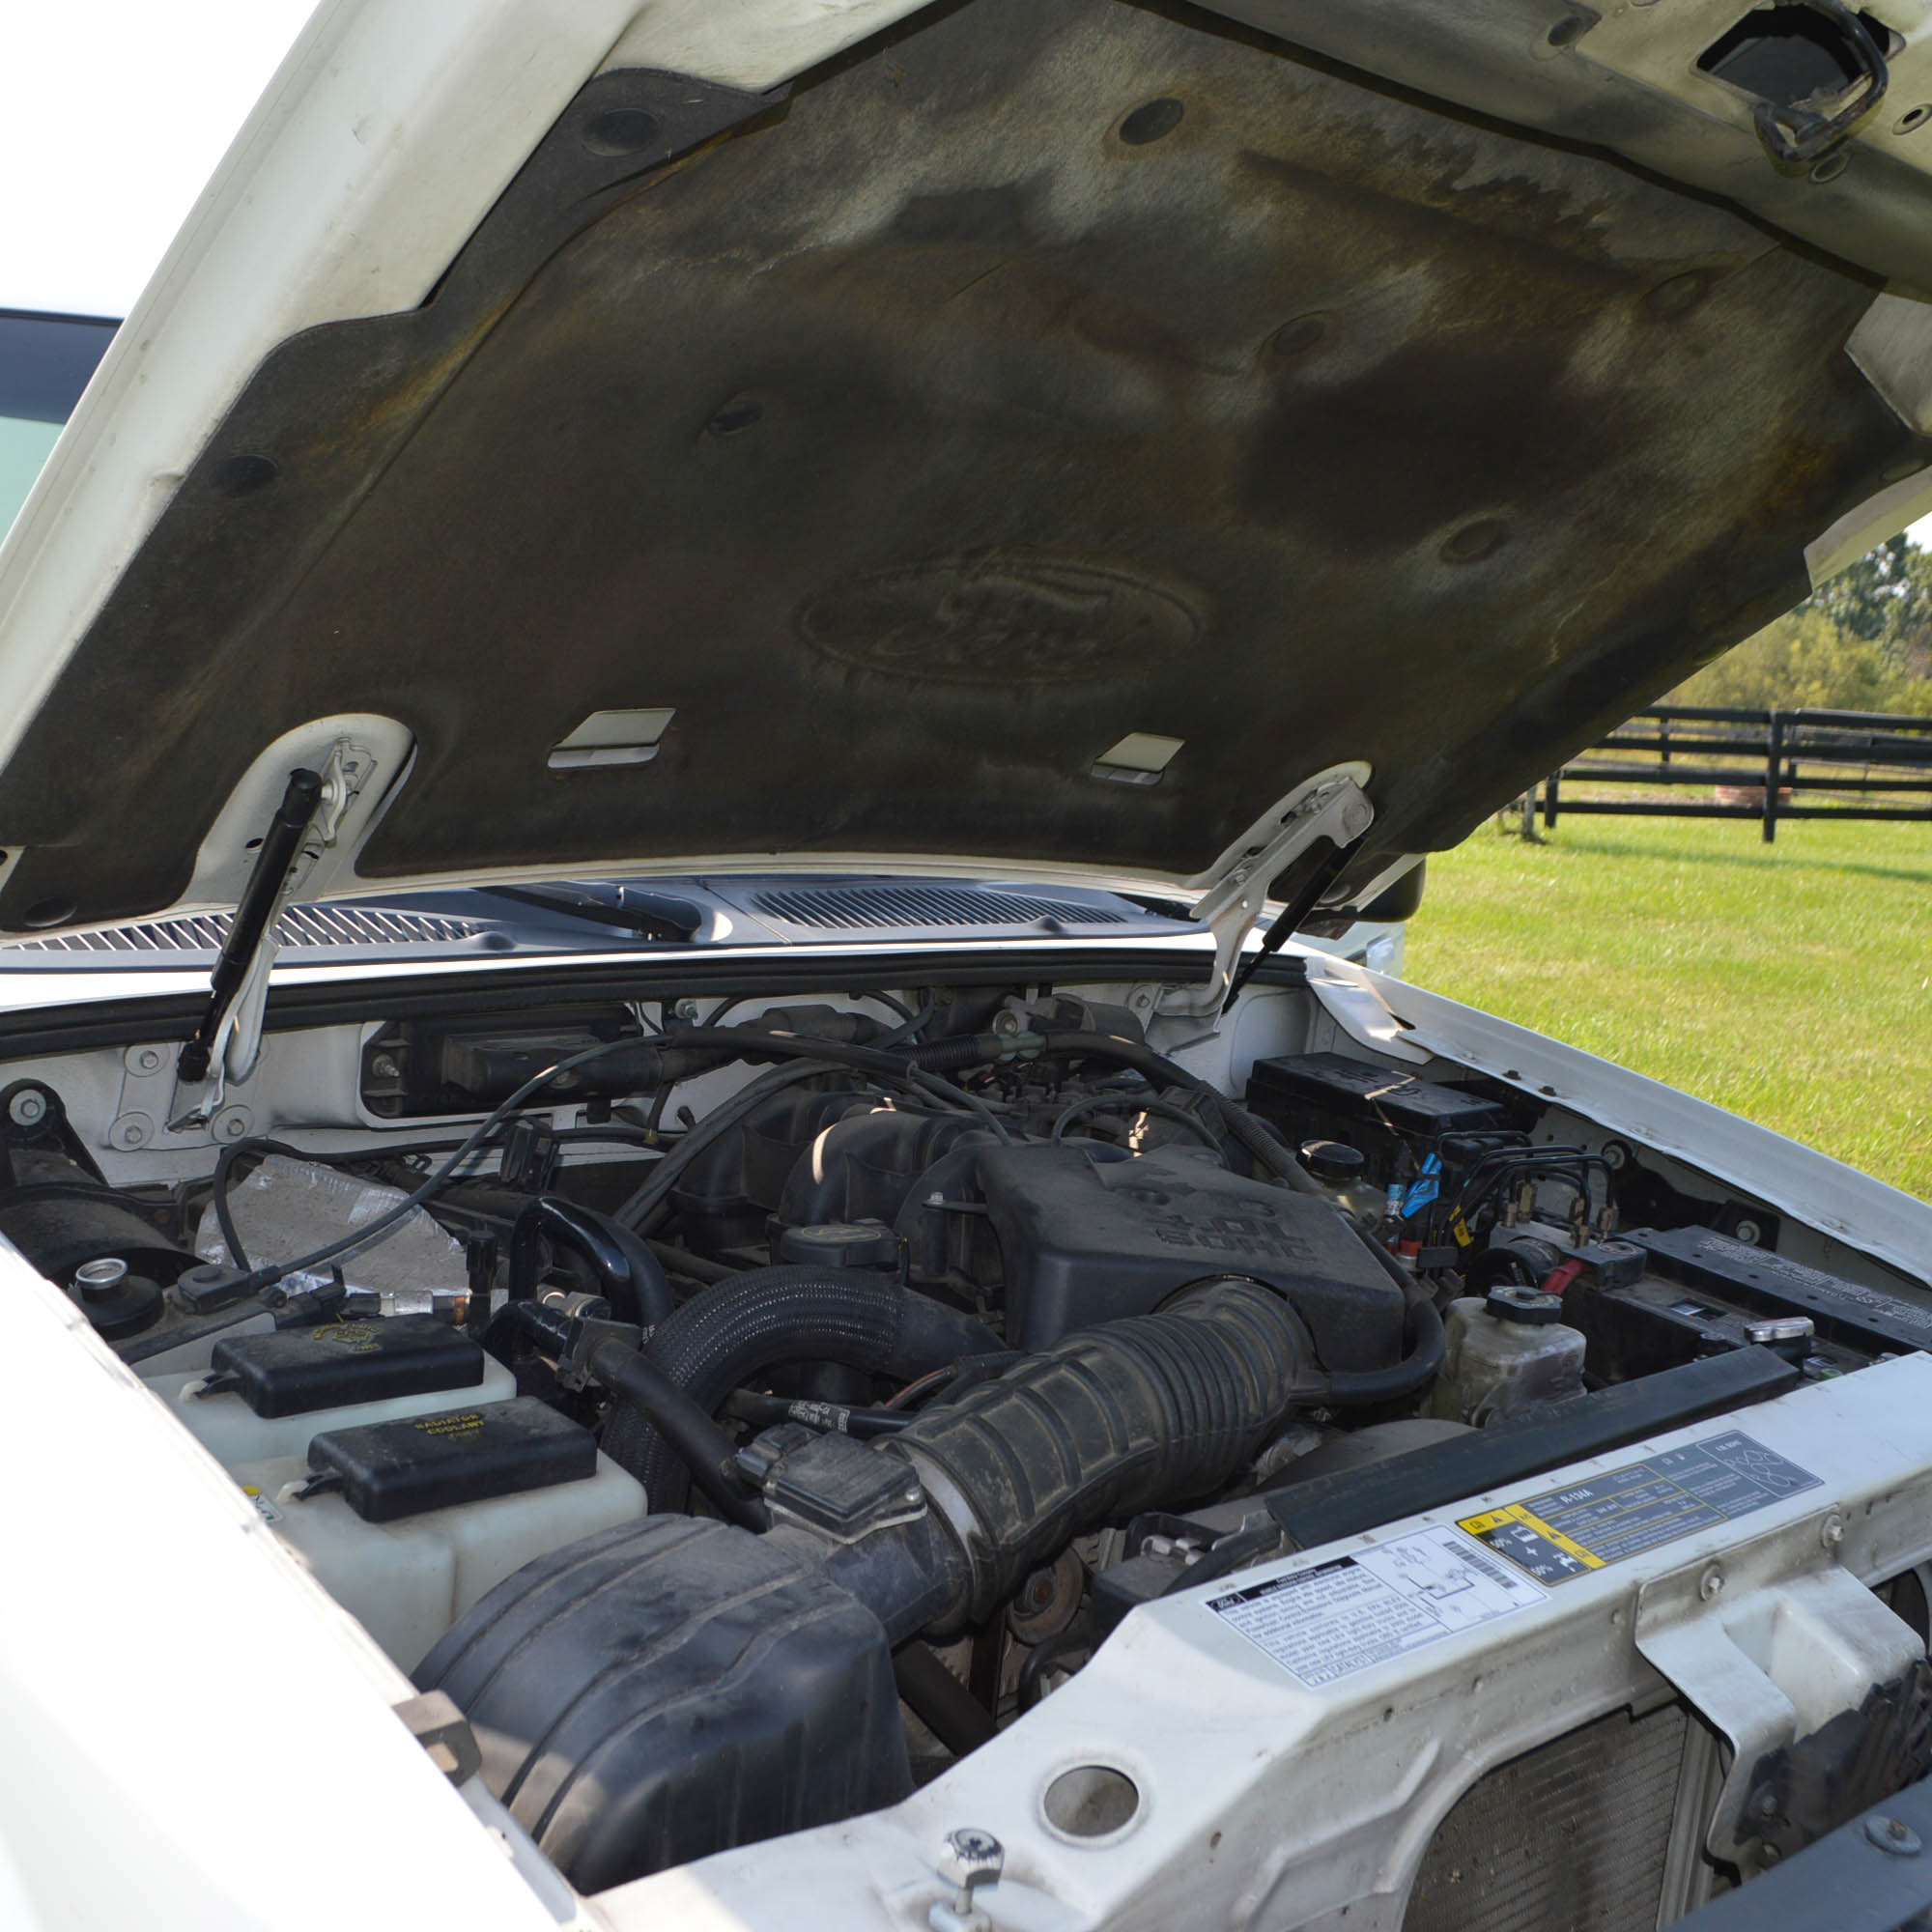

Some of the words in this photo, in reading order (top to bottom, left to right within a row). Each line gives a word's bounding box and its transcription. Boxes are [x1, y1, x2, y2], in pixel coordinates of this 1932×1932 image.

[413, 1413, 480, 1429] RADIATOR
[426, 1419, 485, 1435] COOLANT
[1560, 1489, 1595, 1504] R-134A
